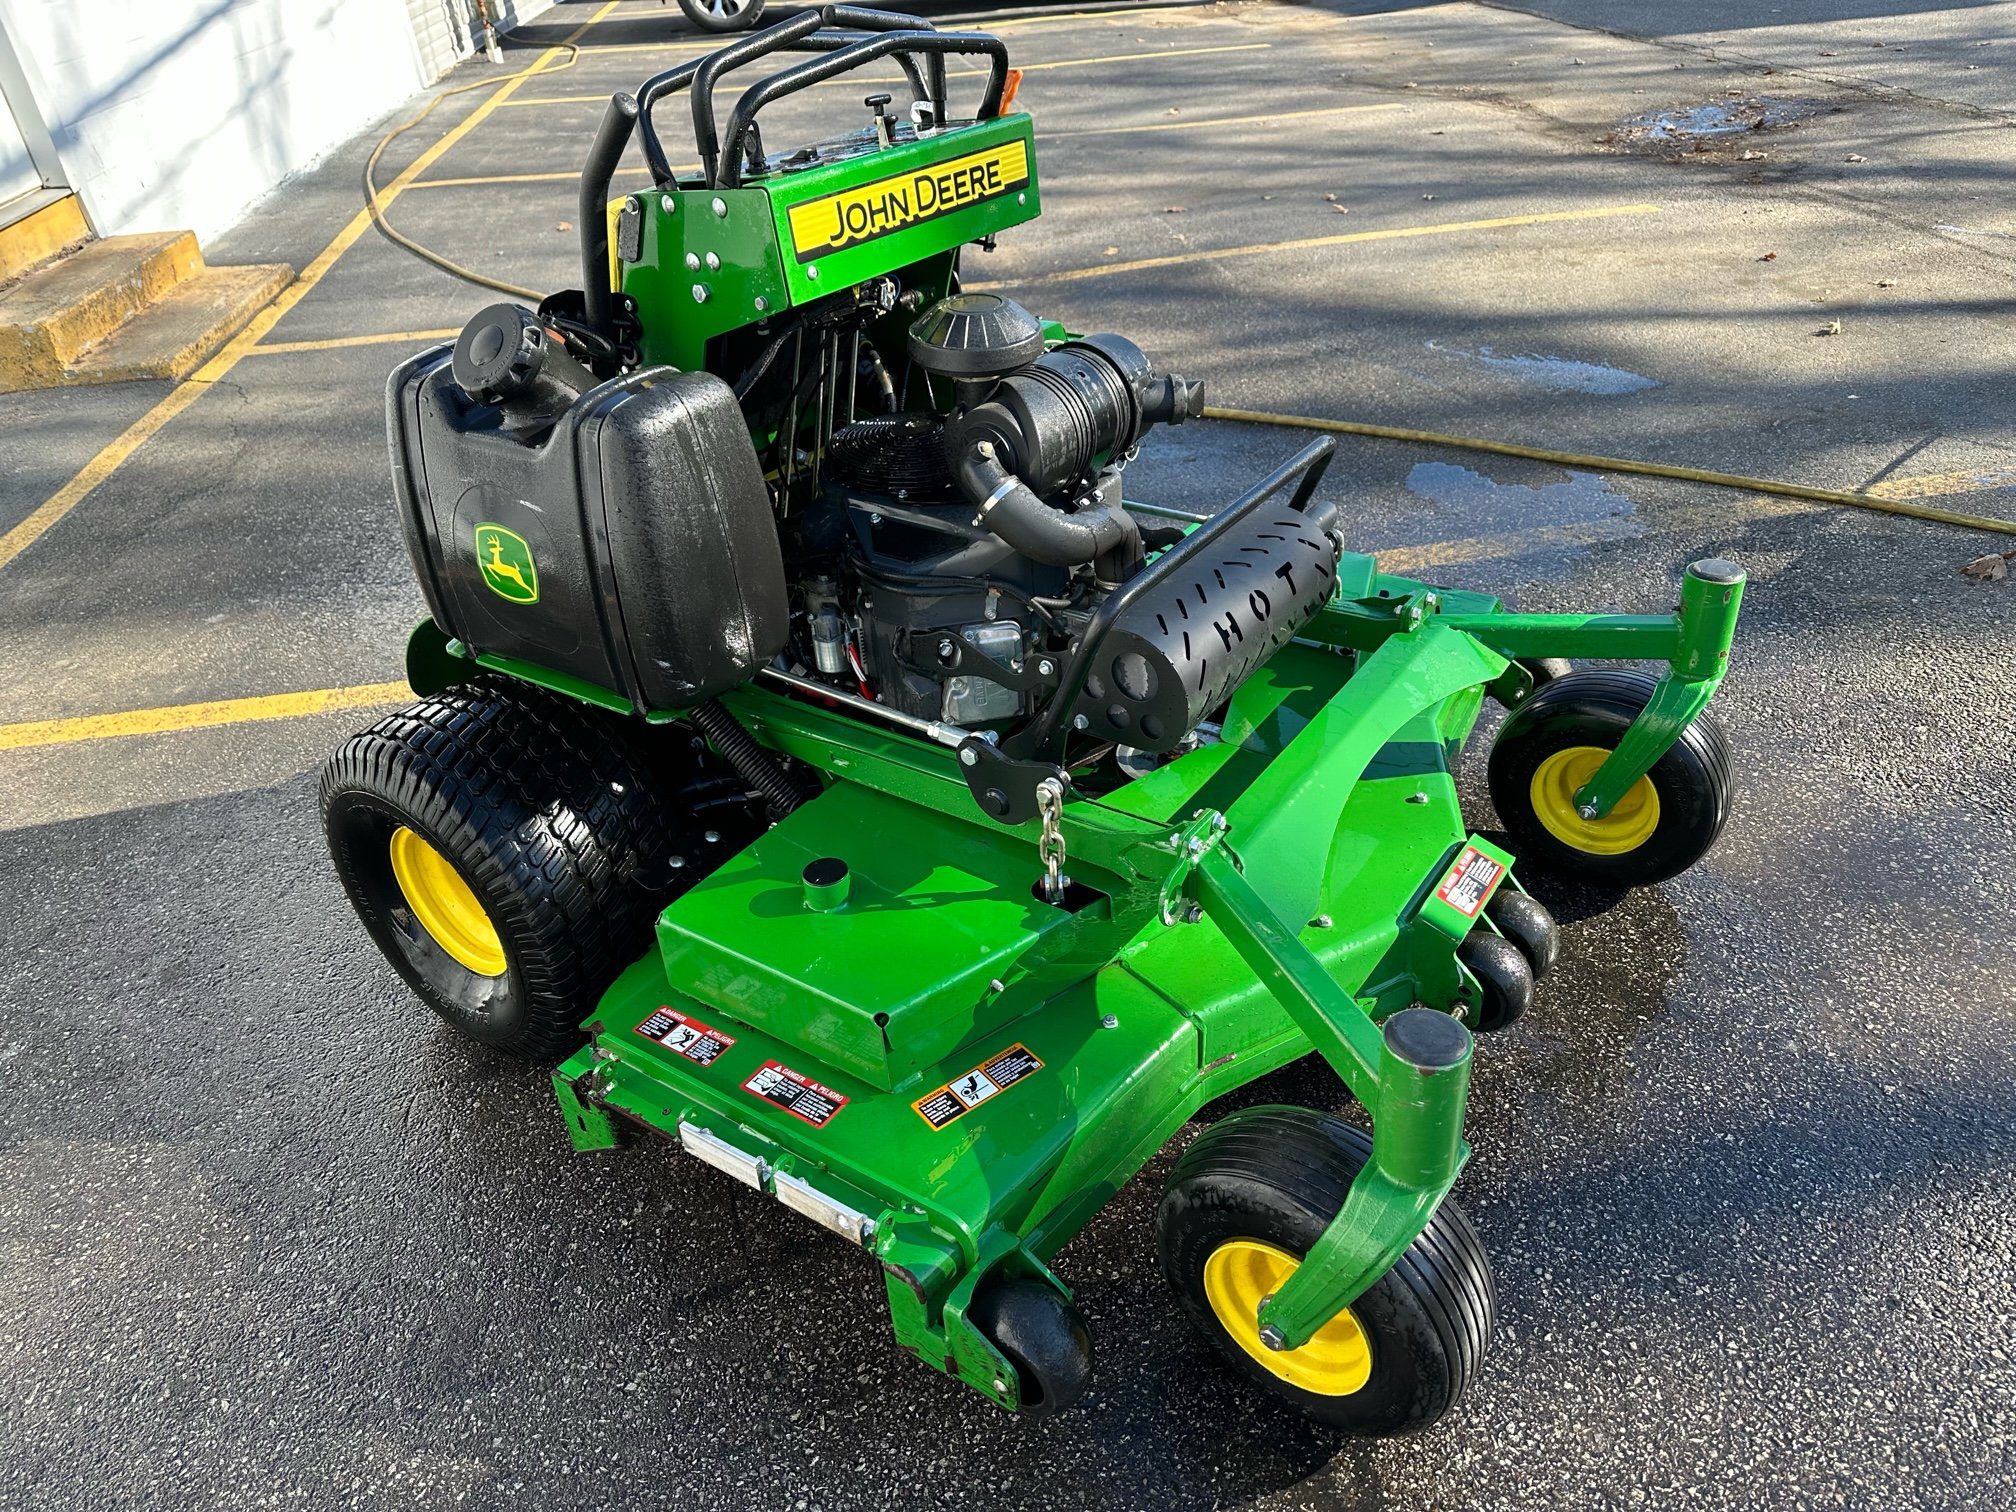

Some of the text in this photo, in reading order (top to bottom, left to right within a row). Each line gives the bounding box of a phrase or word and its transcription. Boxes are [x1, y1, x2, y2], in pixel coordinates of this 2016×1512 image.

[829, 158, 1003, 243] JOHN DEERE
[1213, 561, 1298, 653] HOT
[664, 1008, 688, 1022] DANGER
[710, 1031, 735, 1045] PELIGRO
[781, 1068, 807, 1083] DANGER
[817, 1085, 844, 1102] PELIGRO
[921, 1088, 945, 1104] WARNING
